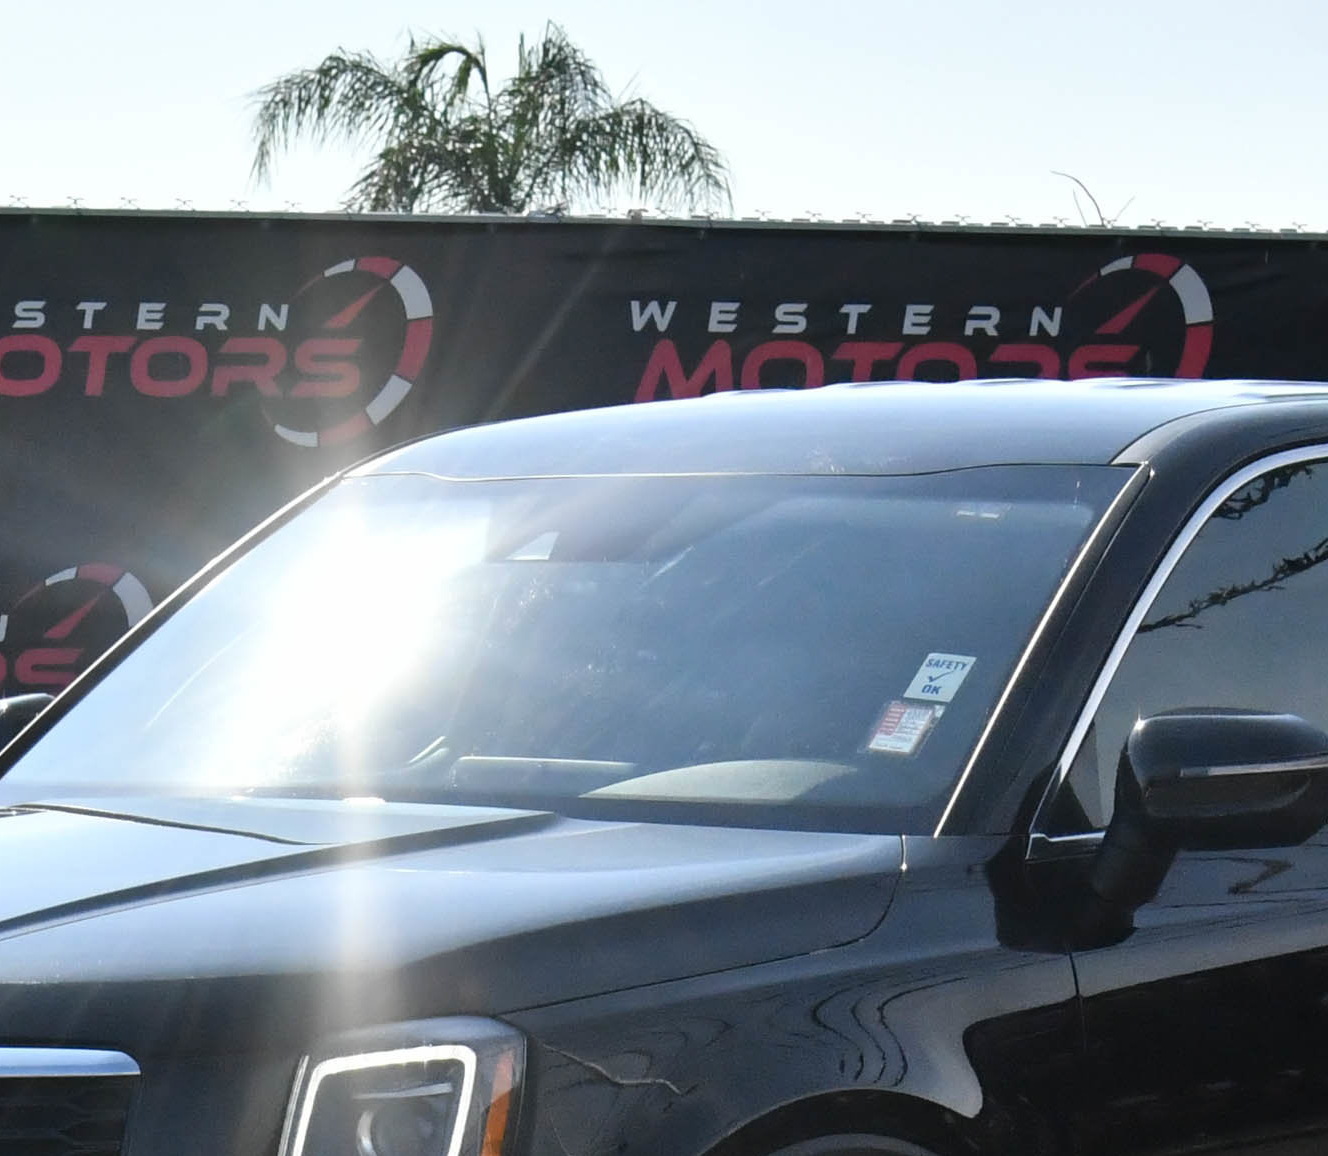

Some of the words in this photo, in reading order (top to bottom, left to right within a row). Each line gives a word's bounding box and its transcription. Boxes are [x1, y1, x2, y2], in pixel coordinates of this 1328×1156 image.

[630, 300, 1062, 337] WESTERN
[634, 339, 1140, 402] MOTORS
[925, 658, 969, 672] SAFETY
[921, 684, 943, 696] OK
